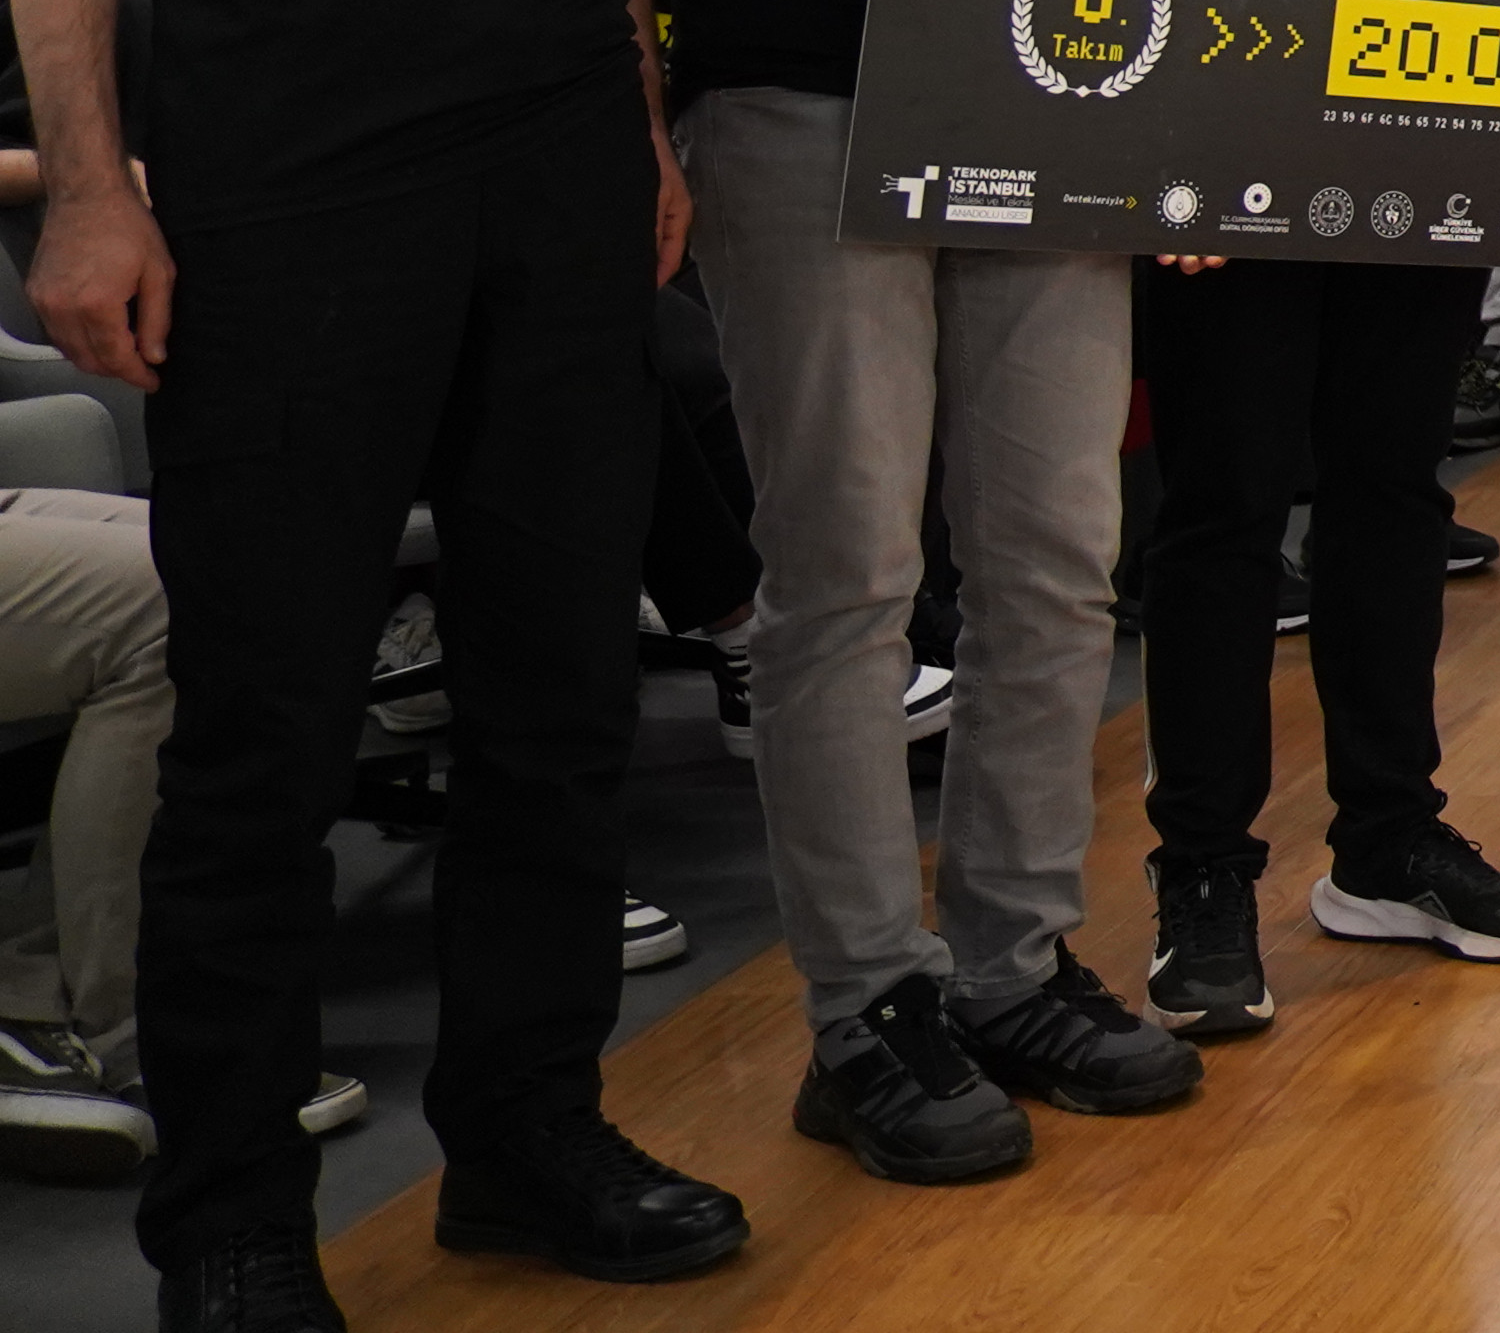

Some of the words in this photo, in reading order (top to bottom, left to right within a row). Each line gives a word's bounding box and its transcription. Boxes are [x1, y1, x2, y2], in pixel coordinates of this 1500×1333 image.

[1052, 33, 1125, 62] Takım
[952, 165, 1037, 183] TEKNOPARK
[948, 175, 1036, 197] İSTANBUL
[1063, 193, 1125, 207] Destekleriyle
